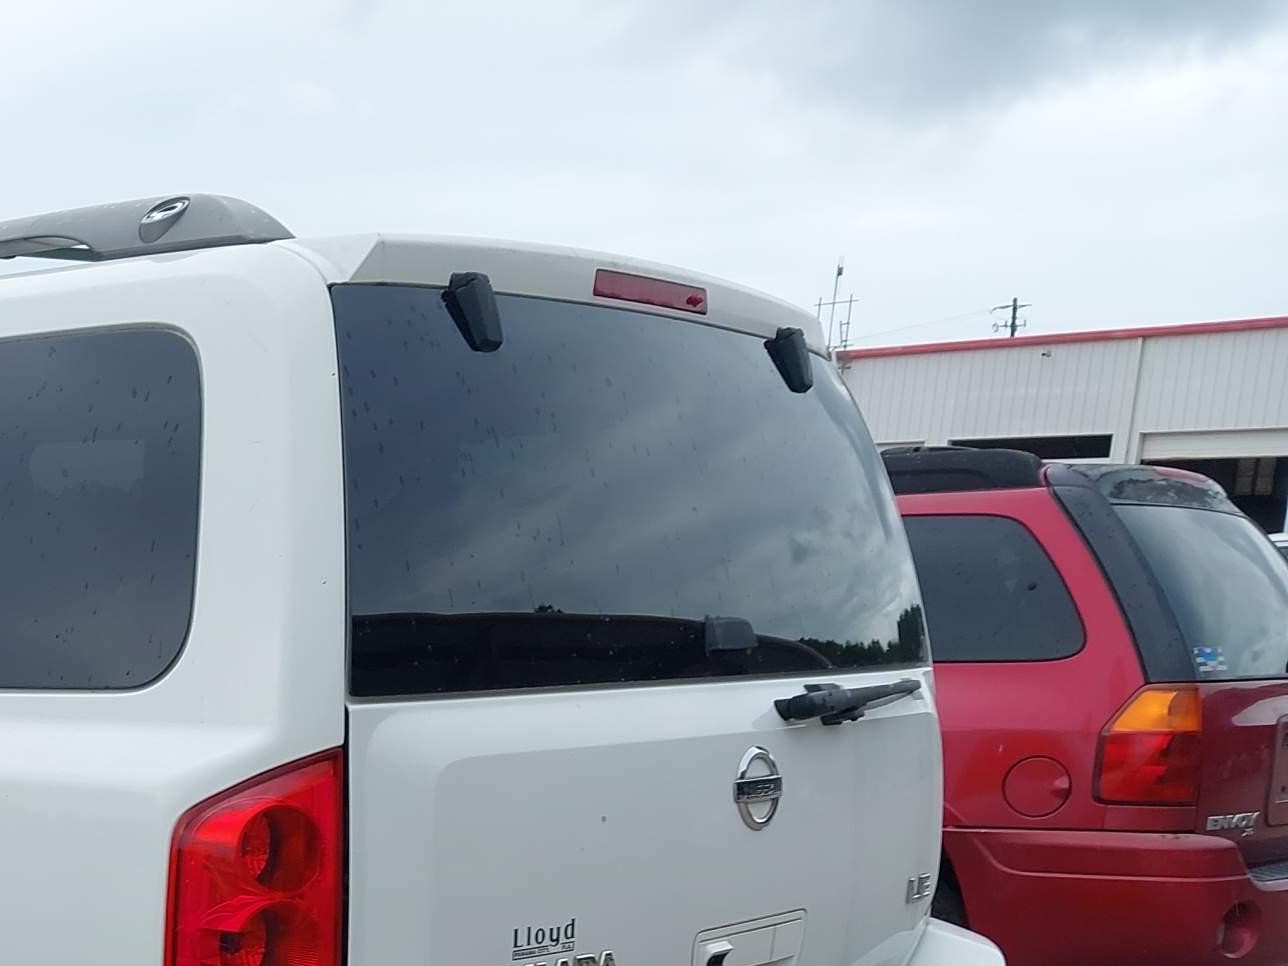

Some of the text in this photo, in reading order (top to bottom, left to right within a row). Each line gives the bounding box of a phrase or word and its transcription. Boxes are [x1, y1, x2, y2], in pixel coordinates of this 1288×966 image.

[1206, 811, 1261, 831] ENVOY
[905, 873, 931, 904] LE
[512, 918, 576, 948] Lloyd
